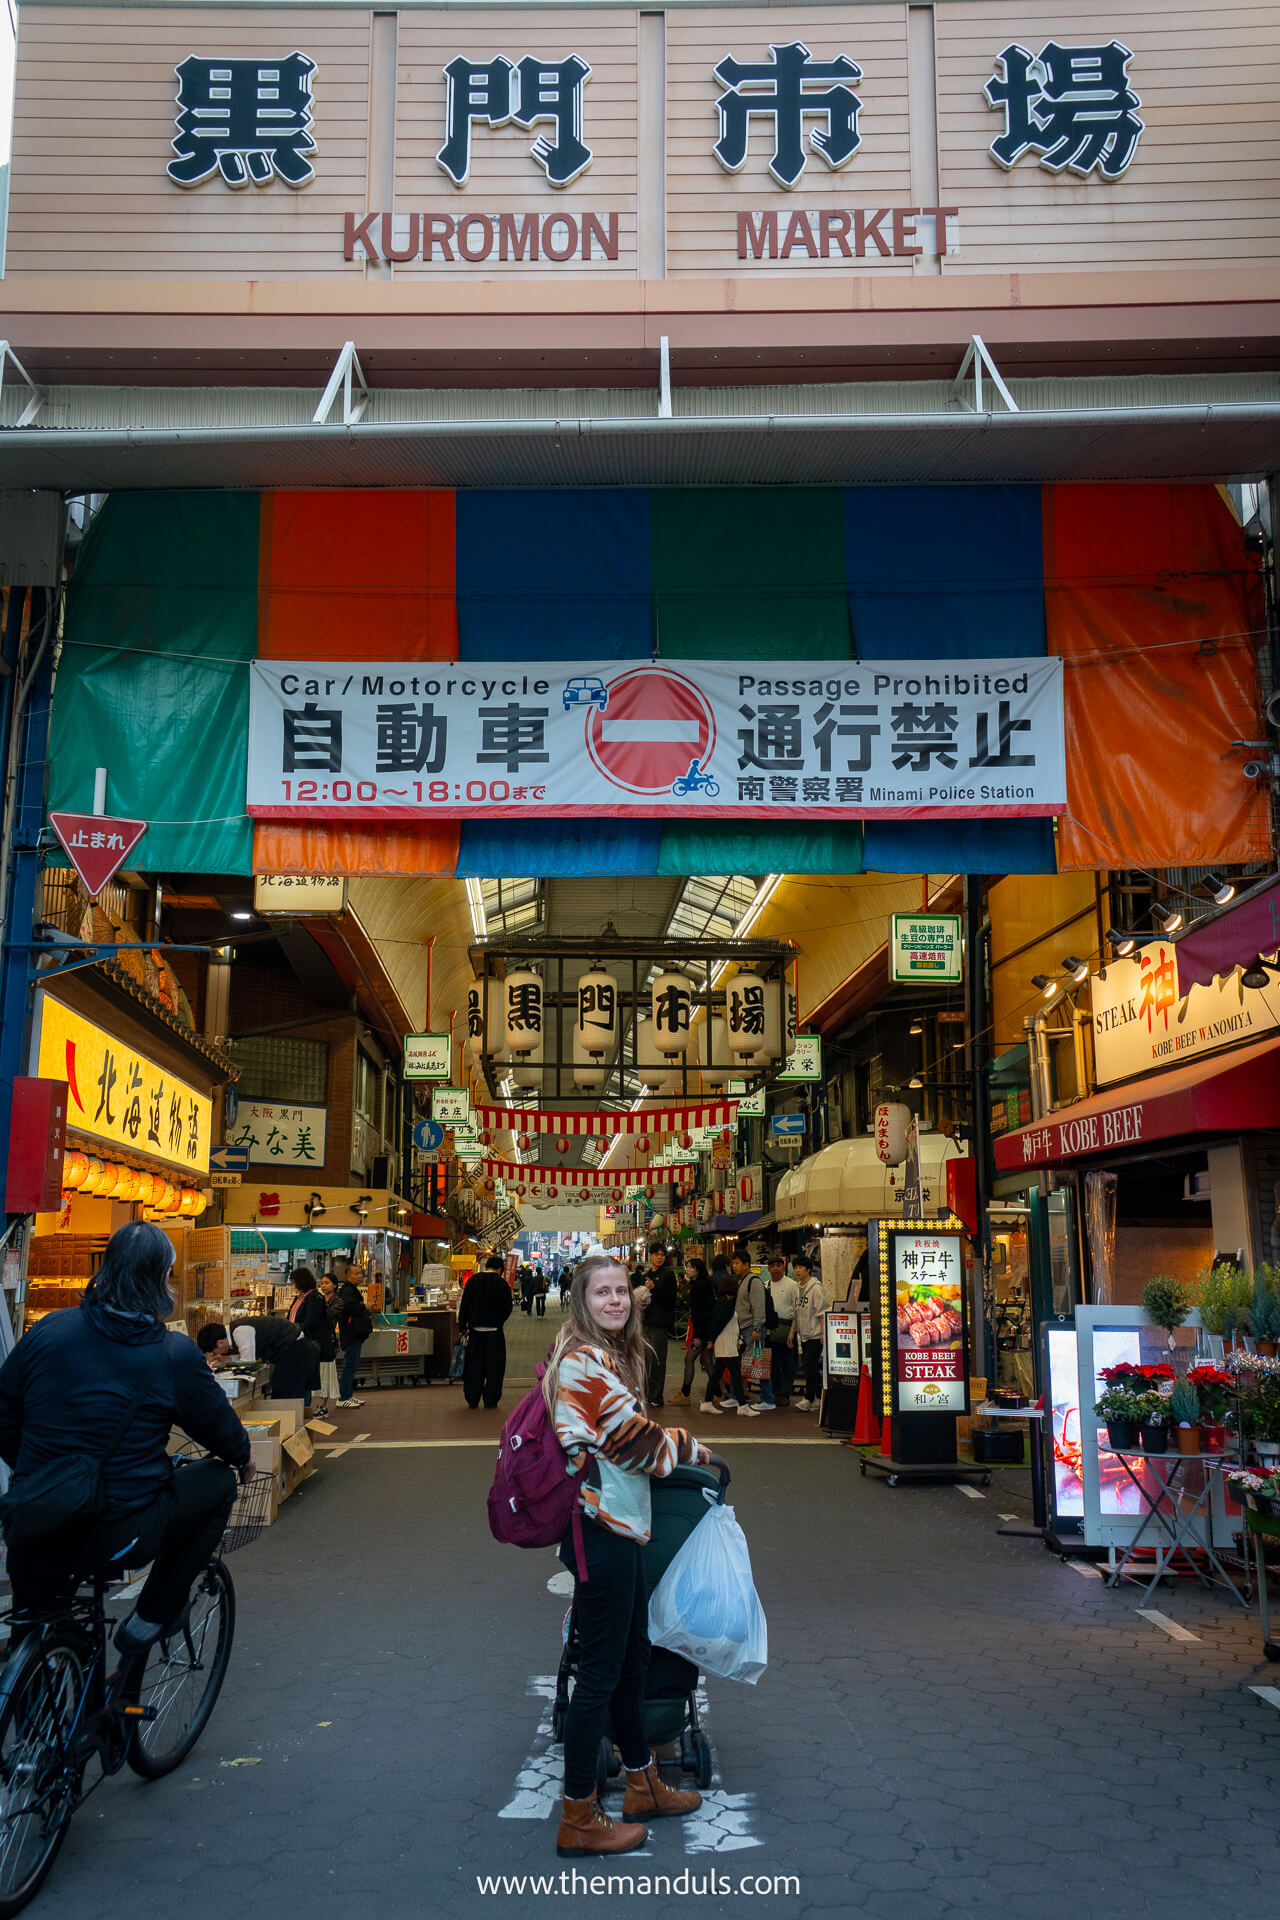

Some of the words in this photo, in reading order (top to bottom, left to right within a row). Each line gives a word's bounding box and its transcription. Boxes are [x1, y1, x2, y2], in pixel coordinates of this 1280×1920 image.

[167, 40, 1145, 189] 黒門市場
[344, 212, 620, 263] KUROMON
[737, 206, 960, 259] MARKET
[279, 673, 551, 700] Car/Motorcycle
[737, 674, 861, 701] Passage
[873, 672, 1029, 696] Prohibited
[281, 702, 550, 774] 自動車
[736, 700, 1036, 773] 通行禁止
[736, 775, 864, 803] 南警察署
[869, 786, 924, 802] Minami
[928, 785, 976, 801] Police
[980, 784, 1035, 800] Station
[69, 829, 126, 850] 止まれ
[900, 933, 954, 943] 生豆の専門店
[909, 924, 945, 934] 高級珈琲
[909, 951, 946, 960] 高速焙煎
[1138, 947, 1176, 1035] 神
[1096, 998, 1138, 1035] STEAK
[1151, 1038, 1174, 1059] KOBE
[1175, 1029, 1198, 1051] BEEF
[1199, 1010, 1253, 1041] WANOMIYA
[94, 1048, 200, 1160] 北海道物語
[249, 1105, 274, 1119] 大阪
[278, 1108, 304, 1122] 黒門
[234, 1124, 316, 1160] みな美
[878, 1106, 891, 1160] ほんまもん
[1021, 1128, 1053, 1163] 神戸牛
[1058, 1116, 1100, 1155] KOBE
[1101, 1104, 1144, 1147] BEEF
[914, 1239, 941, 1249] 鉄板焼
[901, 1250, 954, 1270] 神戸牛
[910, 1270, 948, 1282] ステーキ
[396, 1331, 409, 1353] 活
[904, 1352, 929, 1361] KOBE
[931, 1352, 956, 1361] BEEF
[904, 1365, 957, 1379] STEAK
[913, 1393, 950, 1404] 和ノ宮
